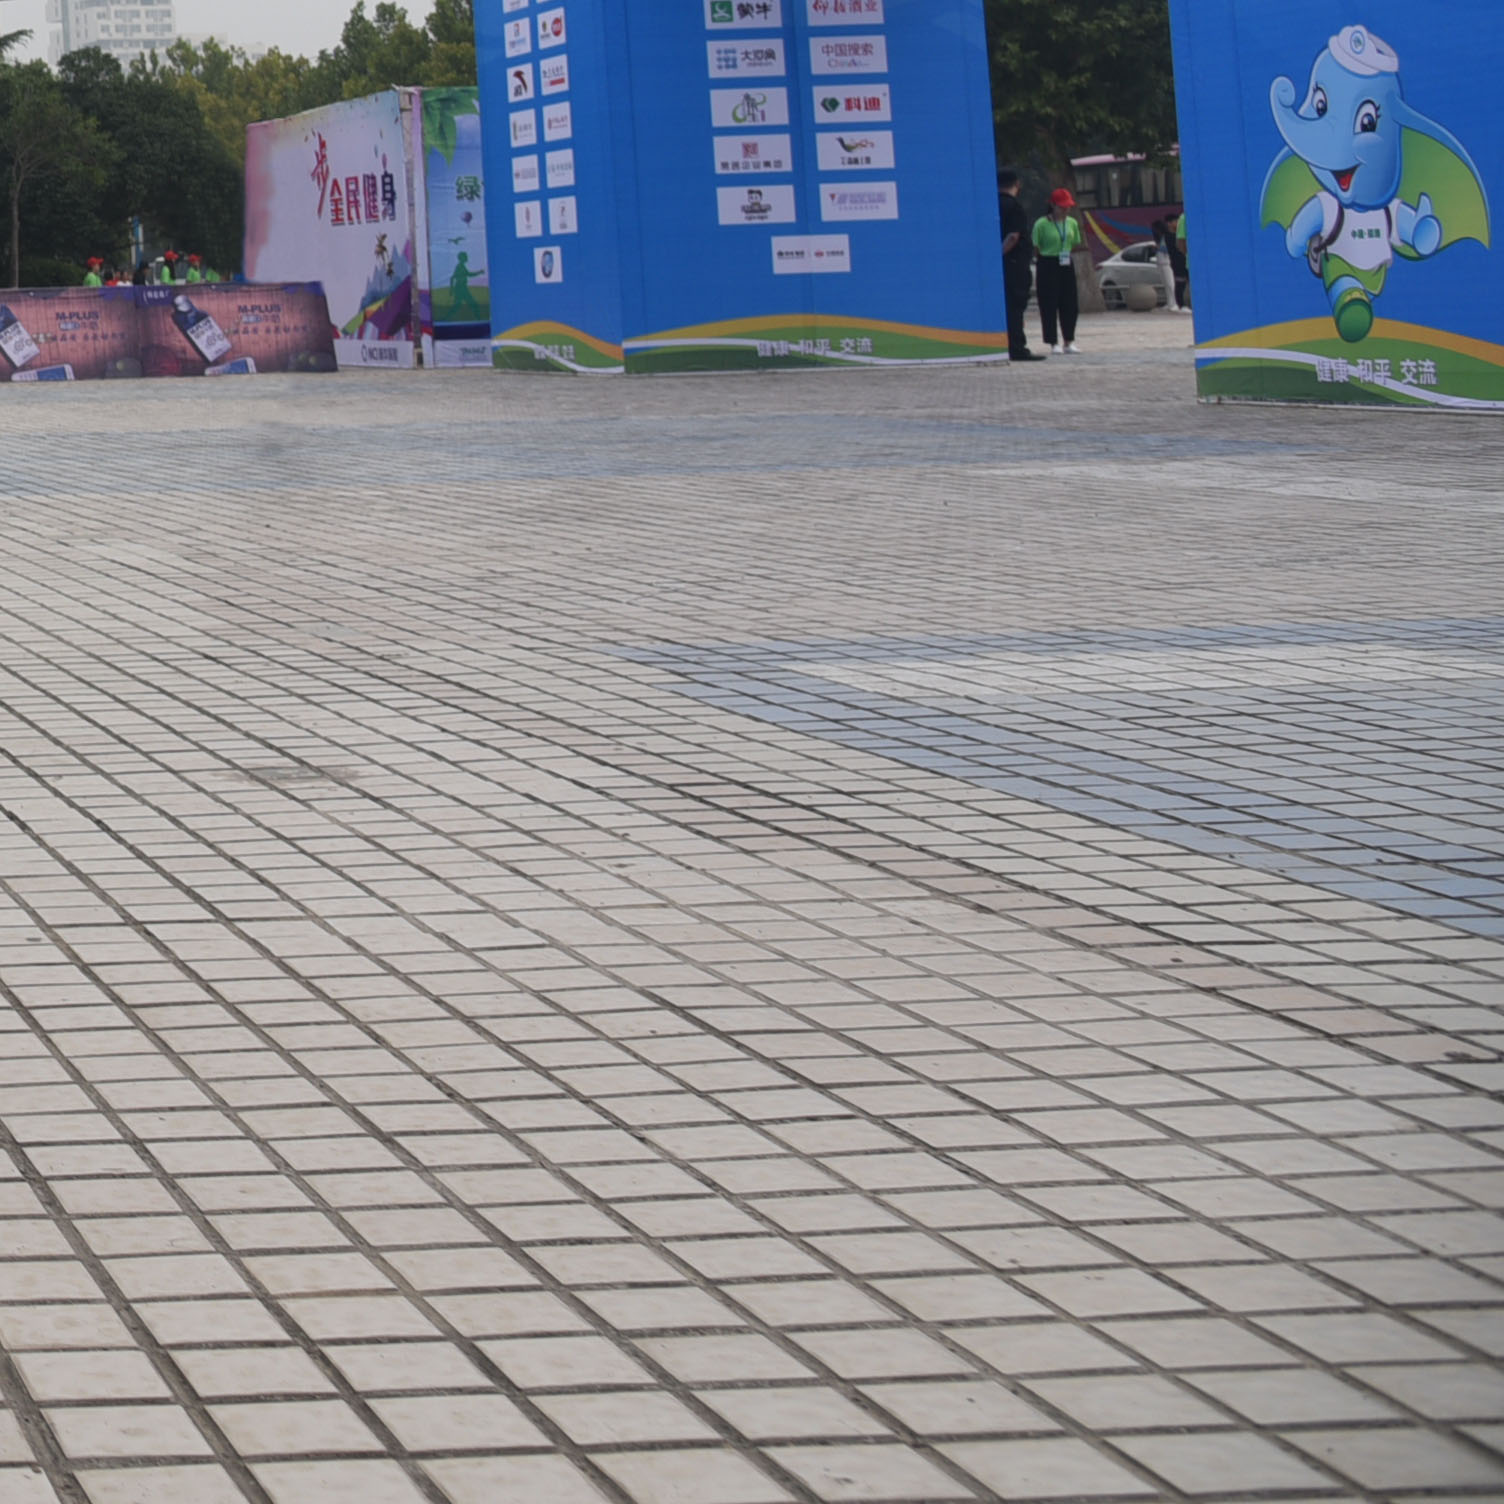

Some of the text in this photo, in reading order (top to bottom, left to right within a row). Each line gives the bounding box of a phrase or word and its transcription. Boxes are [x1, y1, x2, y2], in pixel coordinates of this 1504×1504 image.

[455, 176, 483, 201] 绿
[840, 338, 872, 354] 交流
[1316, 358, 1438, 385] 健康 和平 交流
